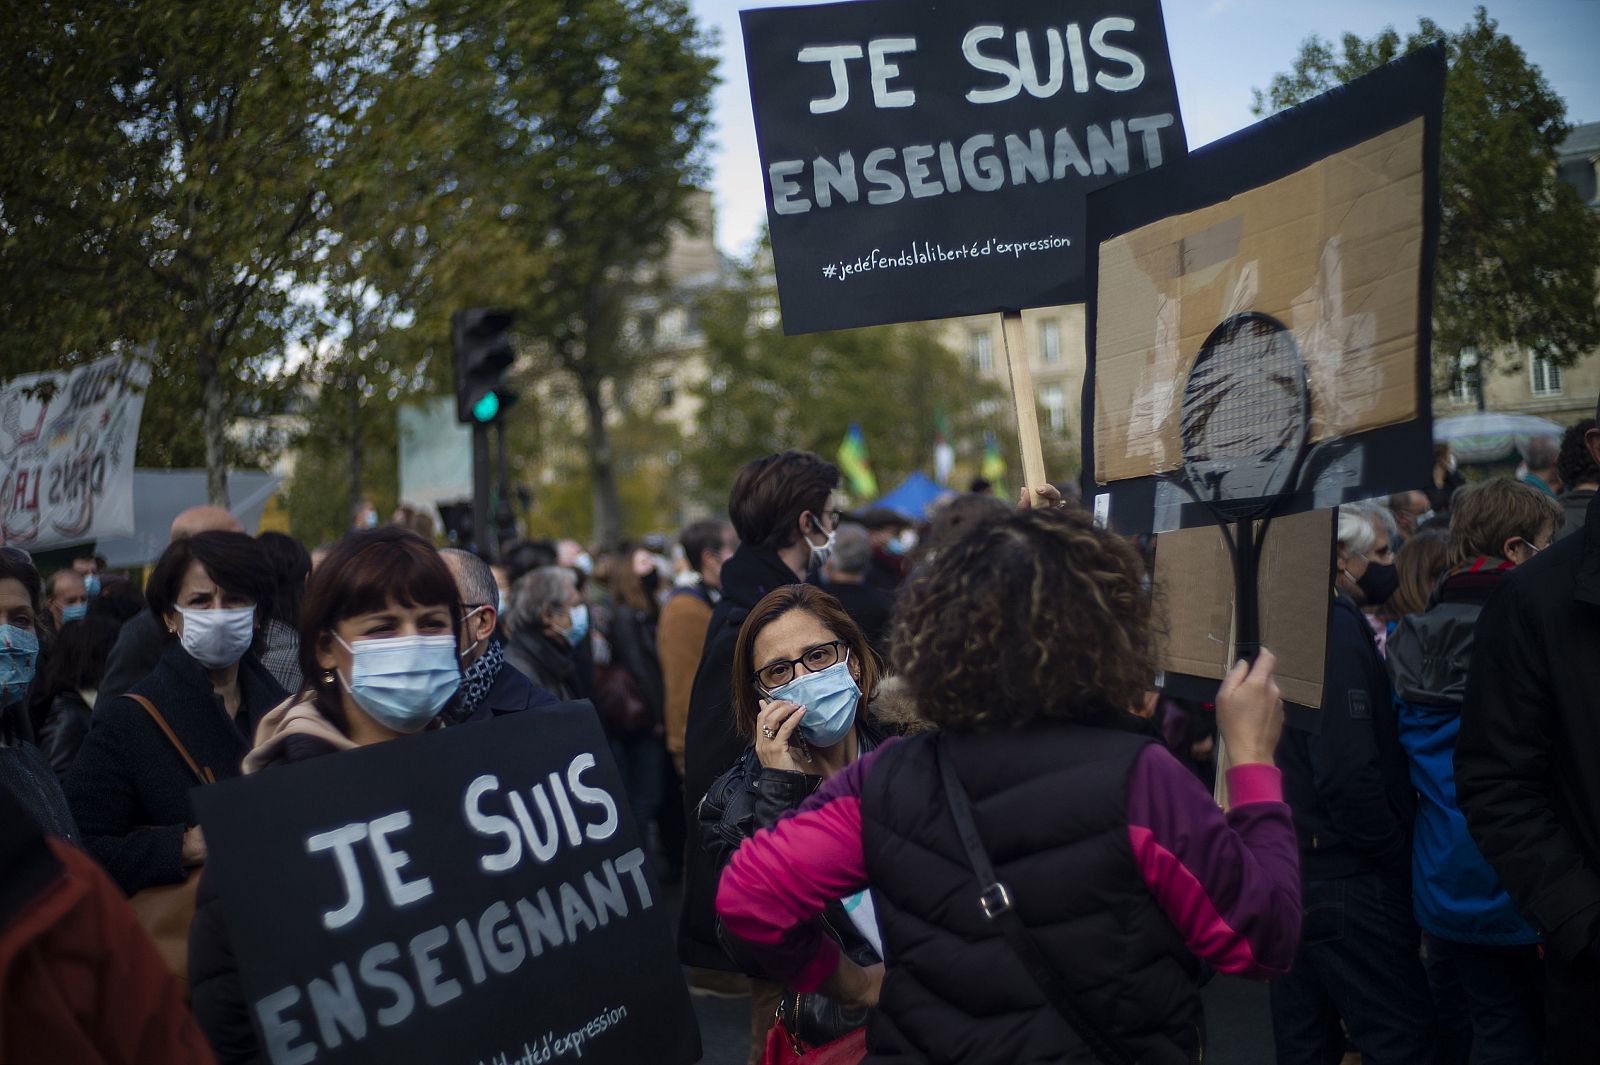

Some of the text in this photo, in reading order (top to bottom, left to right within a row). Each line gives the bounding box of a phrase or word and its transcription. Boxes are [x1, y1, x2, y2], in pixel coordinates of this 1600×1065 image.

[797, 16, 1146, 114] JE SUIS
[769, 112, 1174, 215] ENSEIGNANT
[306, 752, 619, 931] JE SUIS
[253, 847, 654, 1065] ENSEIGNANT
